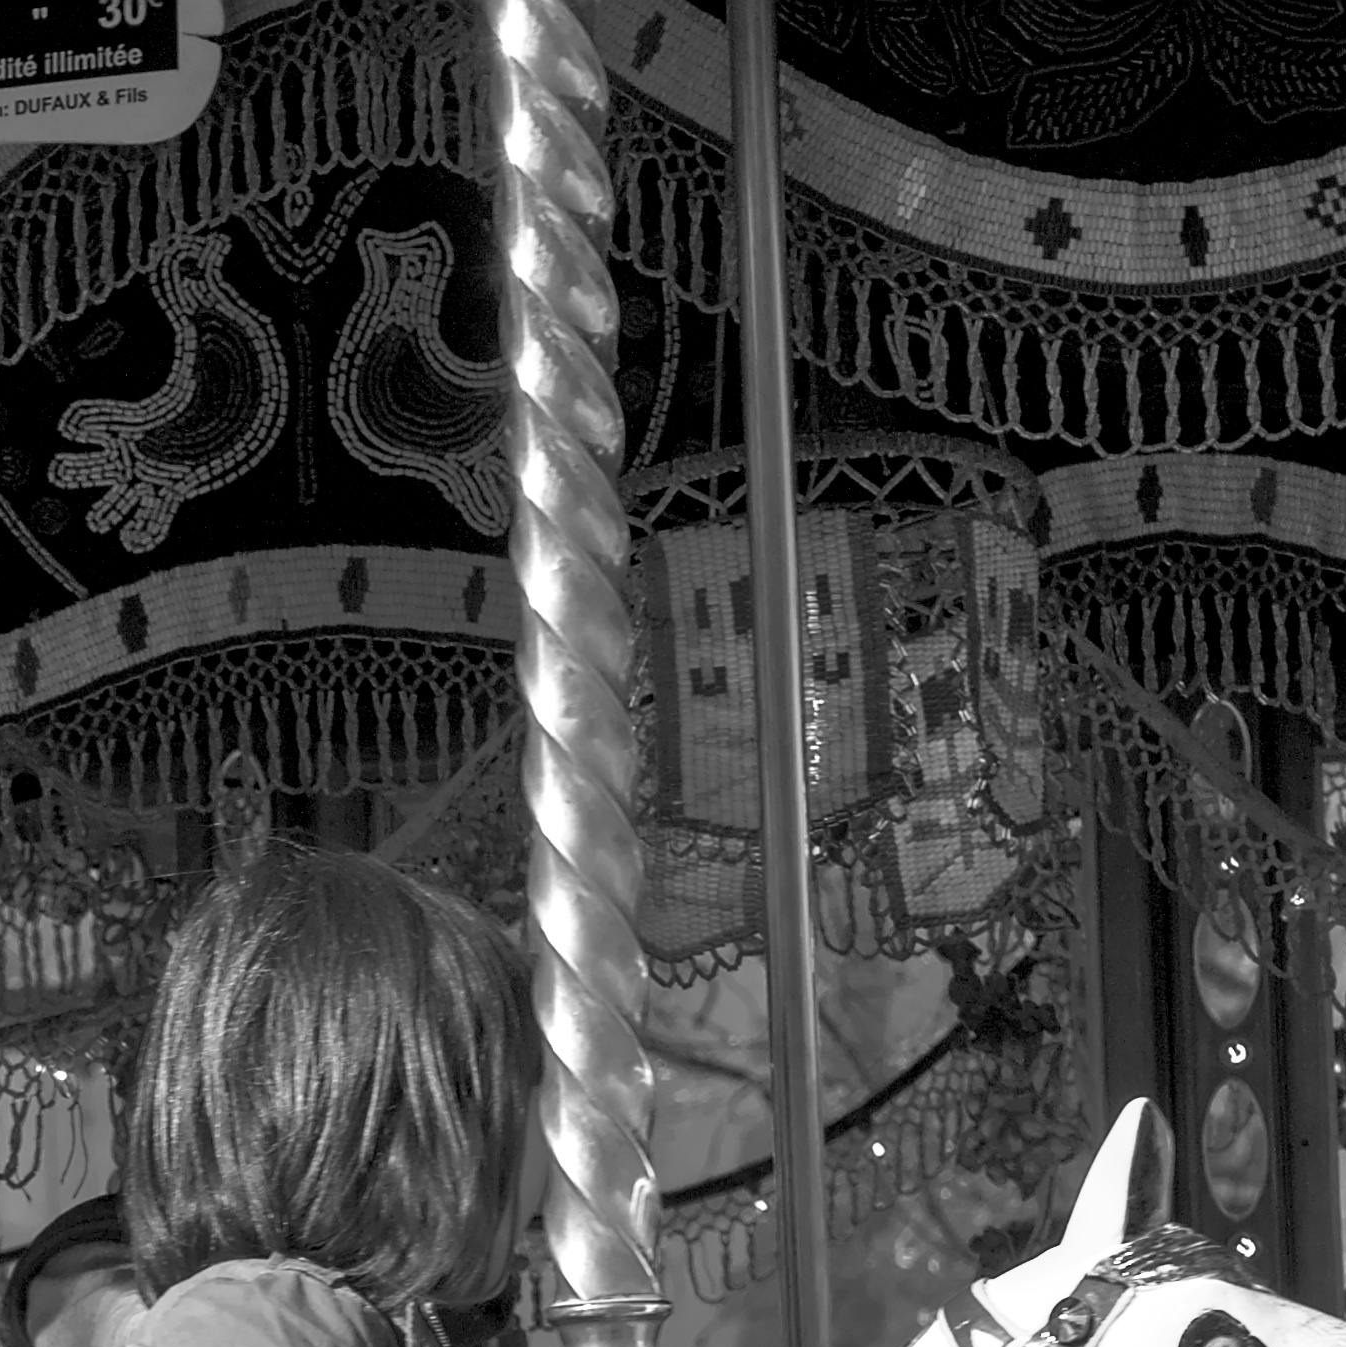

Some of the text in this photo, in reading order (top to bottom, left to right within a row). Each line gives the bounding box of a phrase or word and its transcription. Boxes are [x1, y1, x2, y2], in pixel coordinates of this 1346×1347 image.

[43, 43, 144, 76] illimitée
[14, 92, 91, 116] DUFAUX
[96, 90, 110, 107] &
[115, 88, 148, 105] Fils
